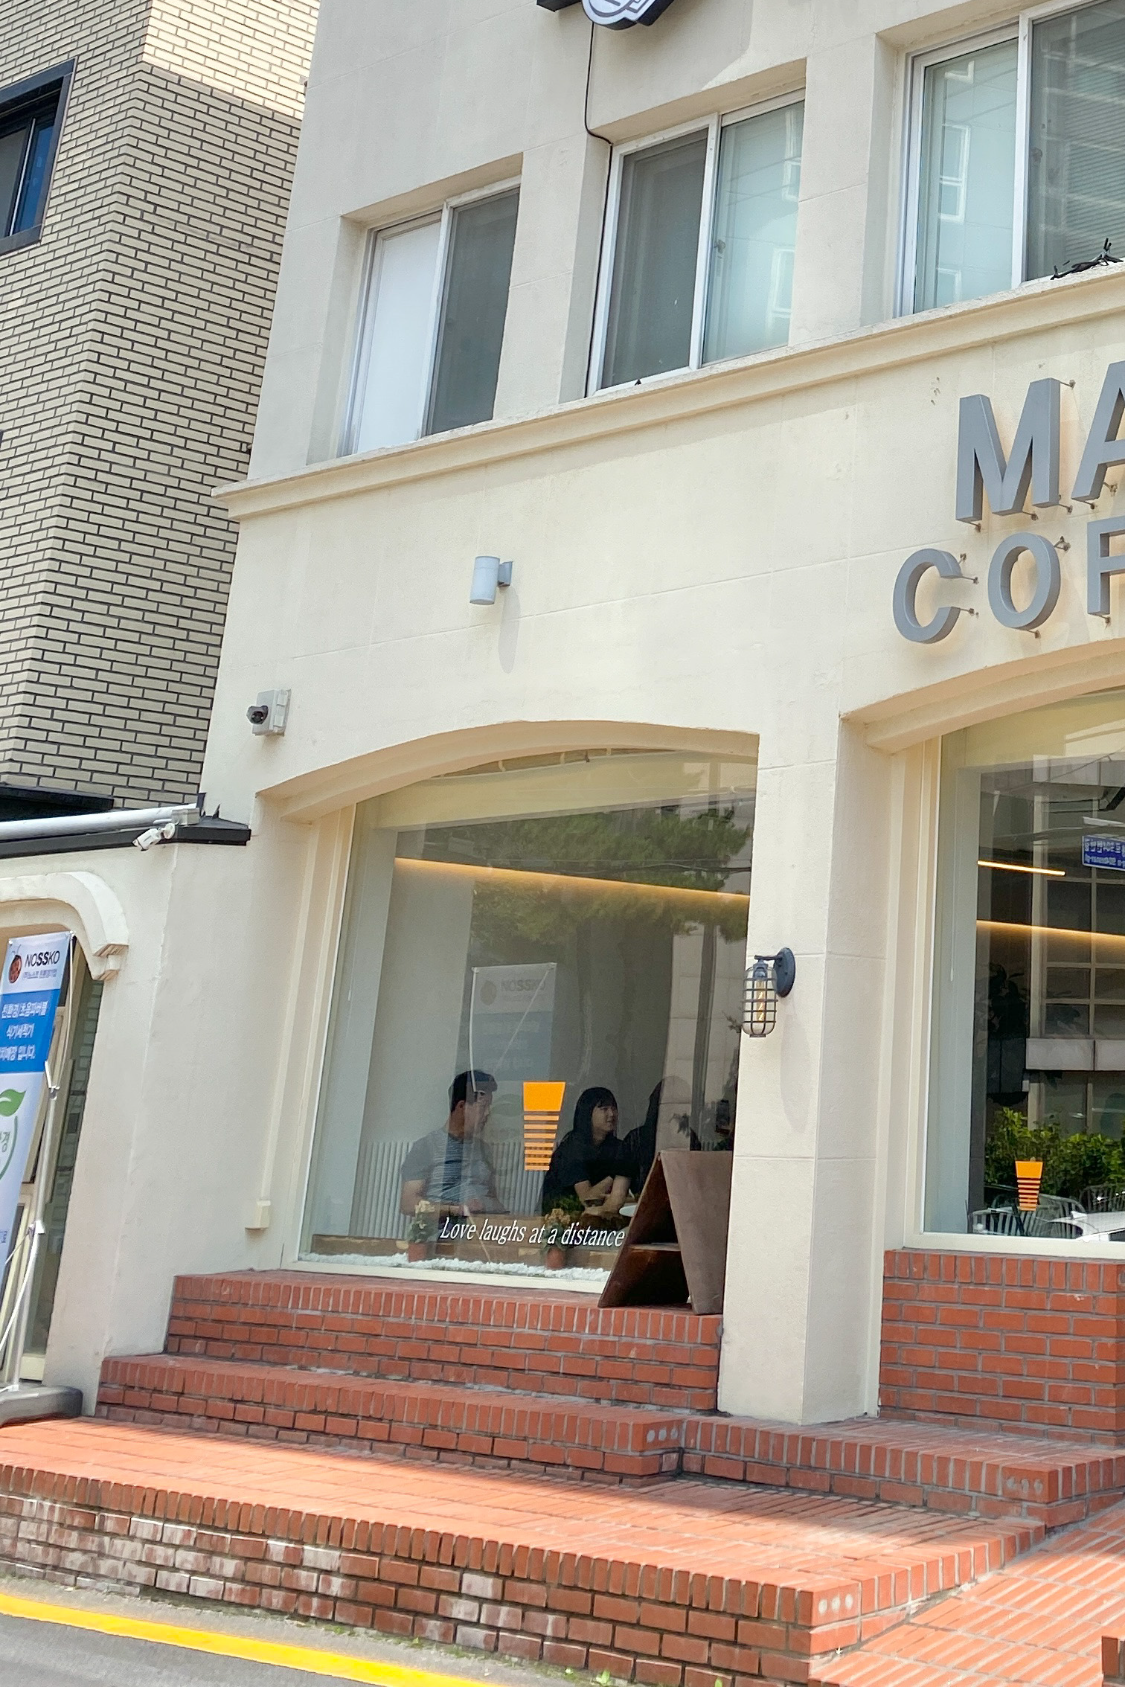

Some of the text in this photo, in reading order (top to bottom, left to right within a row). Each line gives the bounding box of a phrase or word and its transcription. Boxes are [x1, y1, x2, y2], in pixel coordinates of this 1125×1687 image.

[25, 950, 60, 967] NOSSKO
[440, 1216, 625, 1247] Love laughs at a distance
